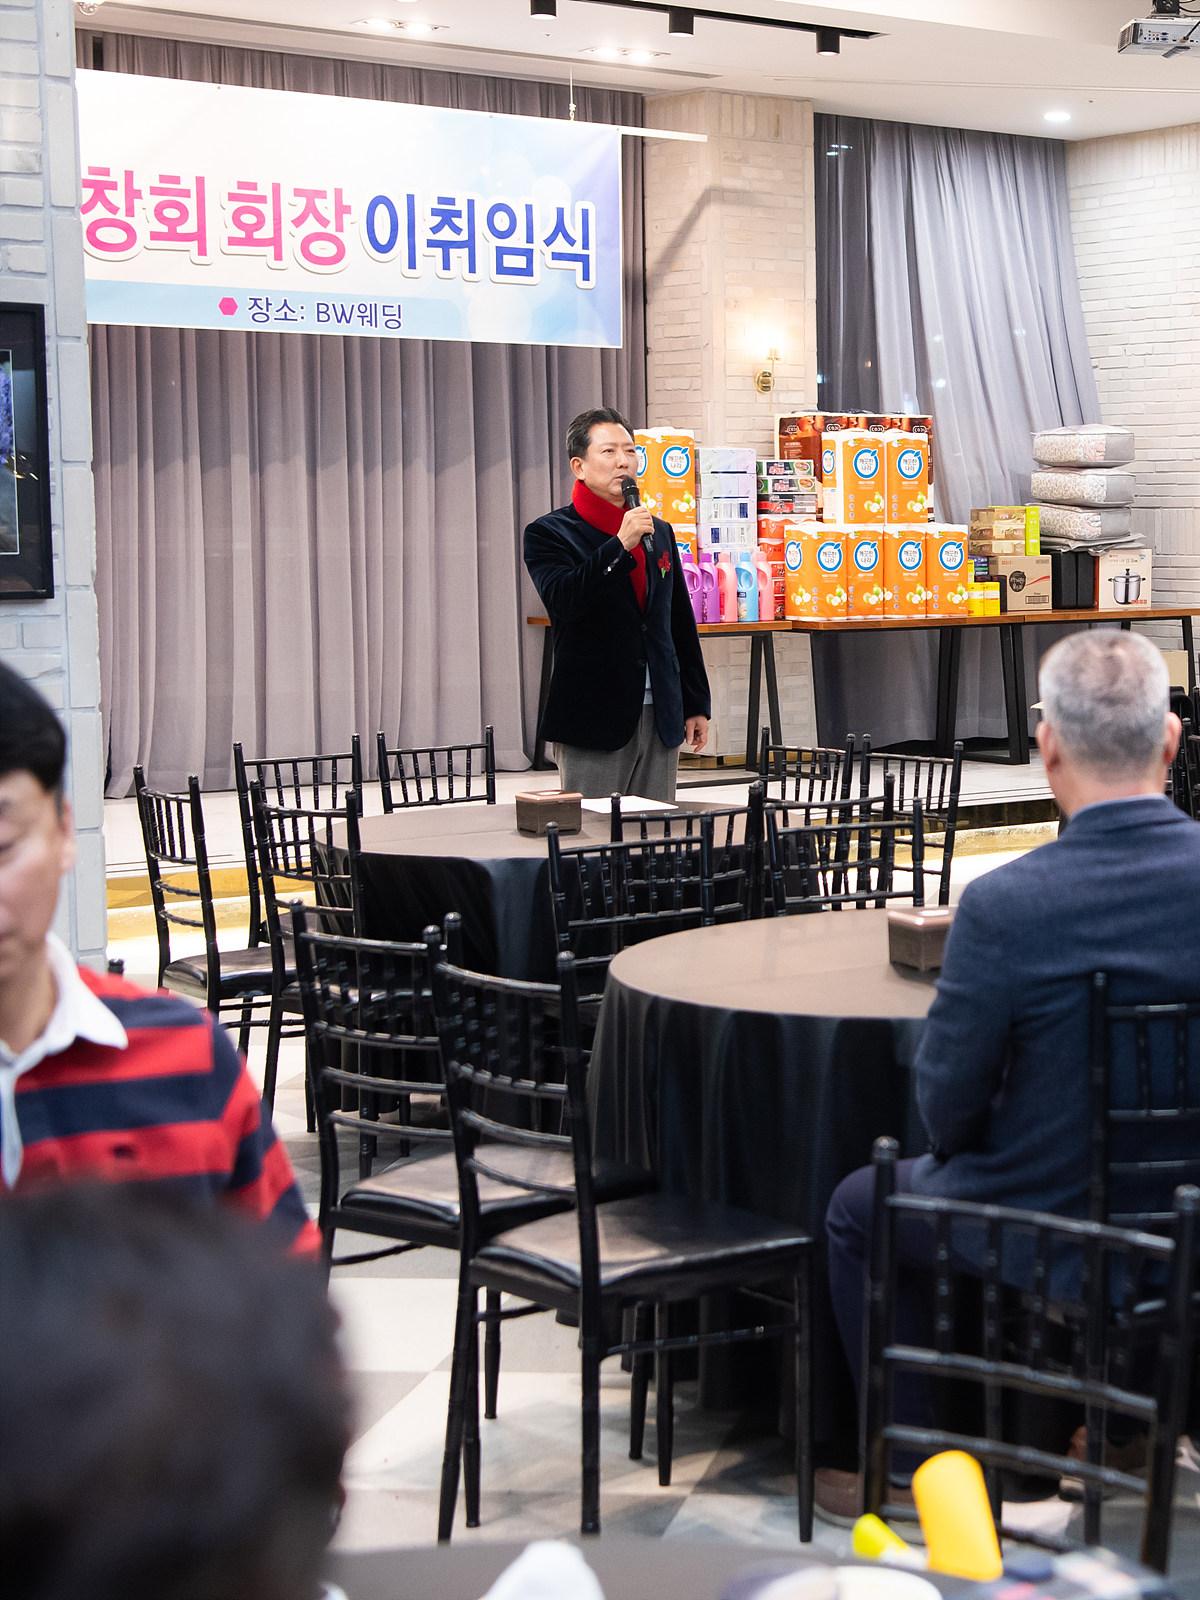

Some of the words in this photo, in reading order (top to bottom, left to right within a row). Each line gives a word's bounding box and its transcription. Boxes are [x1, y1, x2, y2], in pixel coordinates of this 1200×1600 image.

[80, 165, 207, 257] 창회
[227, 180, 351, 266] 회장
[366, 193, 590, 282] 이취임식
[247, 296, 305, 323] 장소:
[316, 302, 403, 330] BW웨딩
